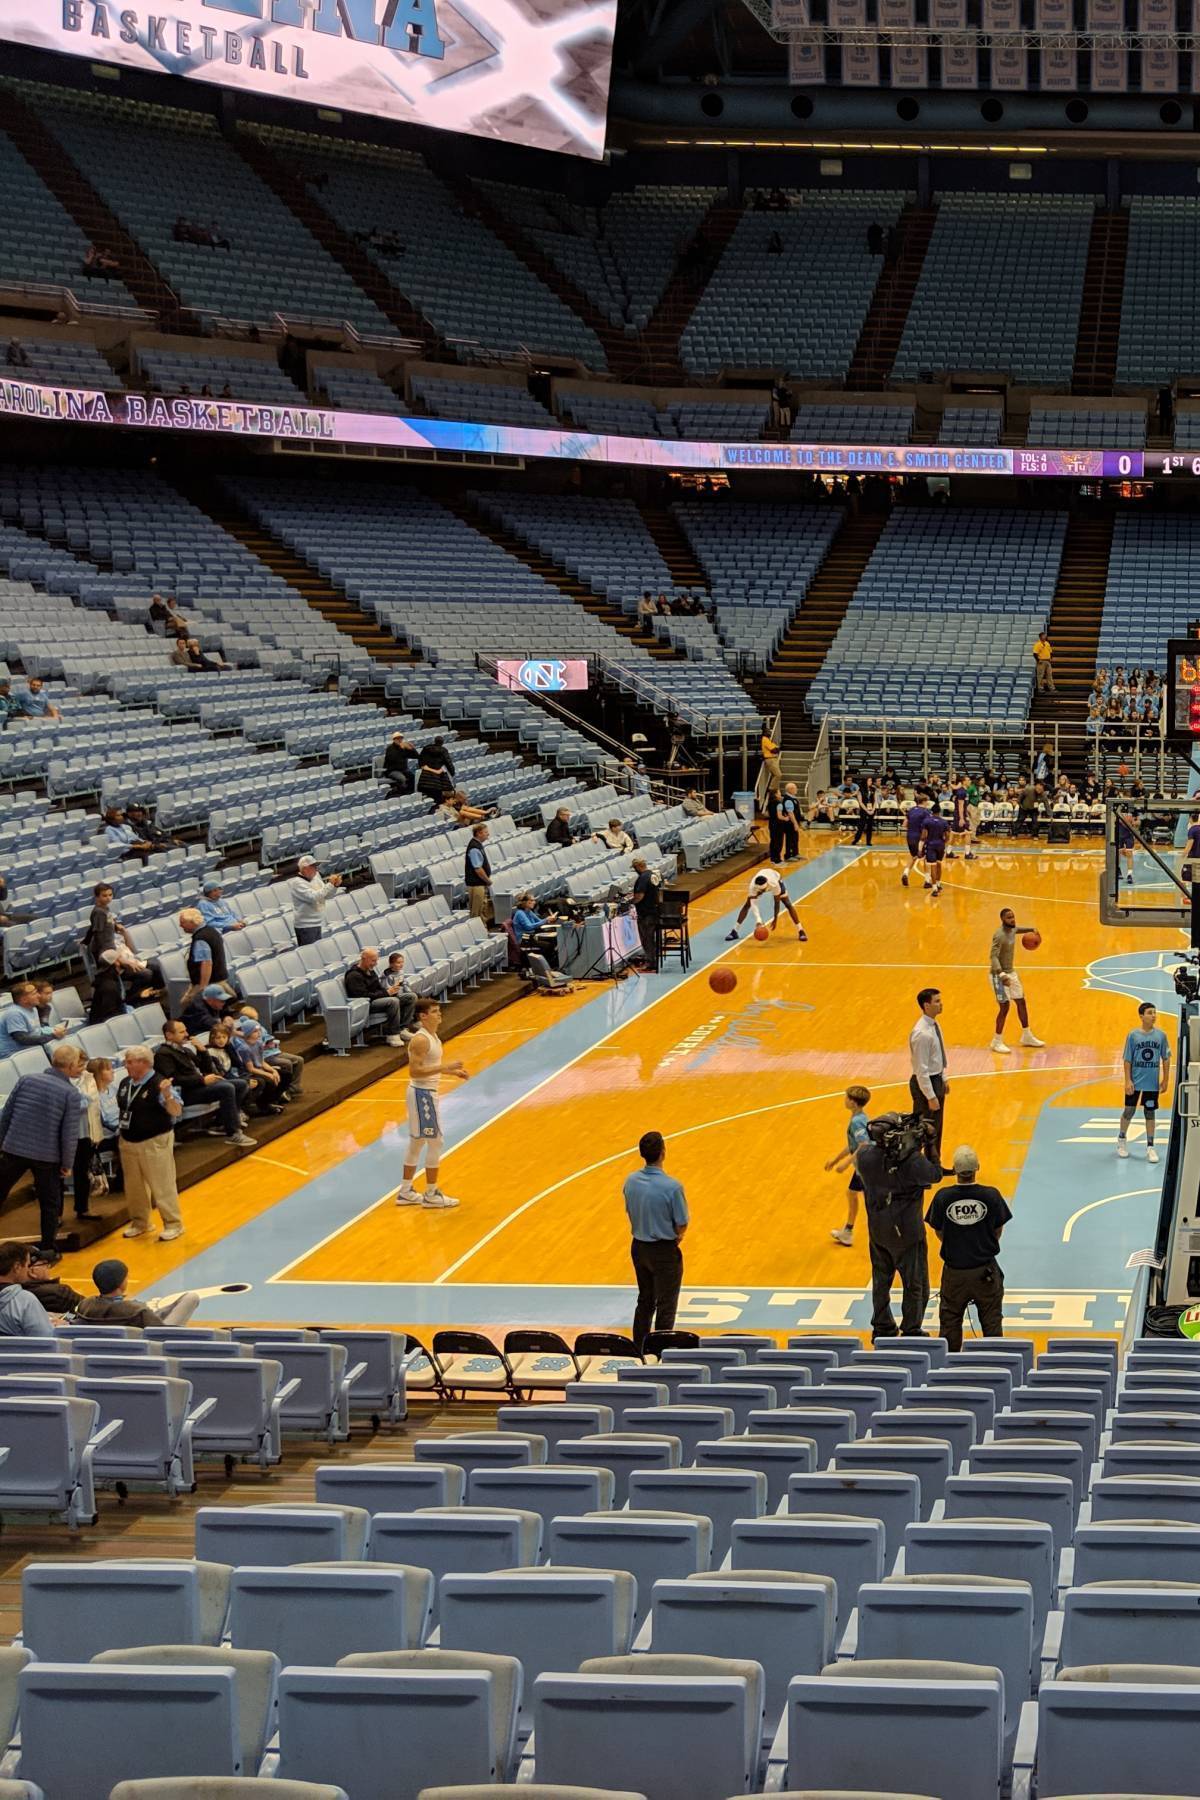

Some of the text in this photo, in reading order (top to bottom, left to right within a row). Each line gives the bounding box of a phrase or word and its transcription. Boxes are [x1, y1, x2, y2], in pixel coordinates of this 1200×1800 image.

[62, 0, 309, 79] BASKETBALL
[126, 394, 335, 439] BASKETBALL
[727, 449, 791, 464] WELCOME
[799, 450, 812, 465] TO
[819, 451, 842, 465] THE
[848, 452, 882, 466] DEAN
[906, 453, 949, 468] SMITH
[955, 453, 1004, 469] CENTER
[1020, 453, 1047, 463] TOL: 4
[1020, 462, 1047, 472] FLS: 0
[1118, 456, 1131, 474] 0
[1162, 456, 1185, 474] 1ST
[955, 1204, 978, 1215] FOX
